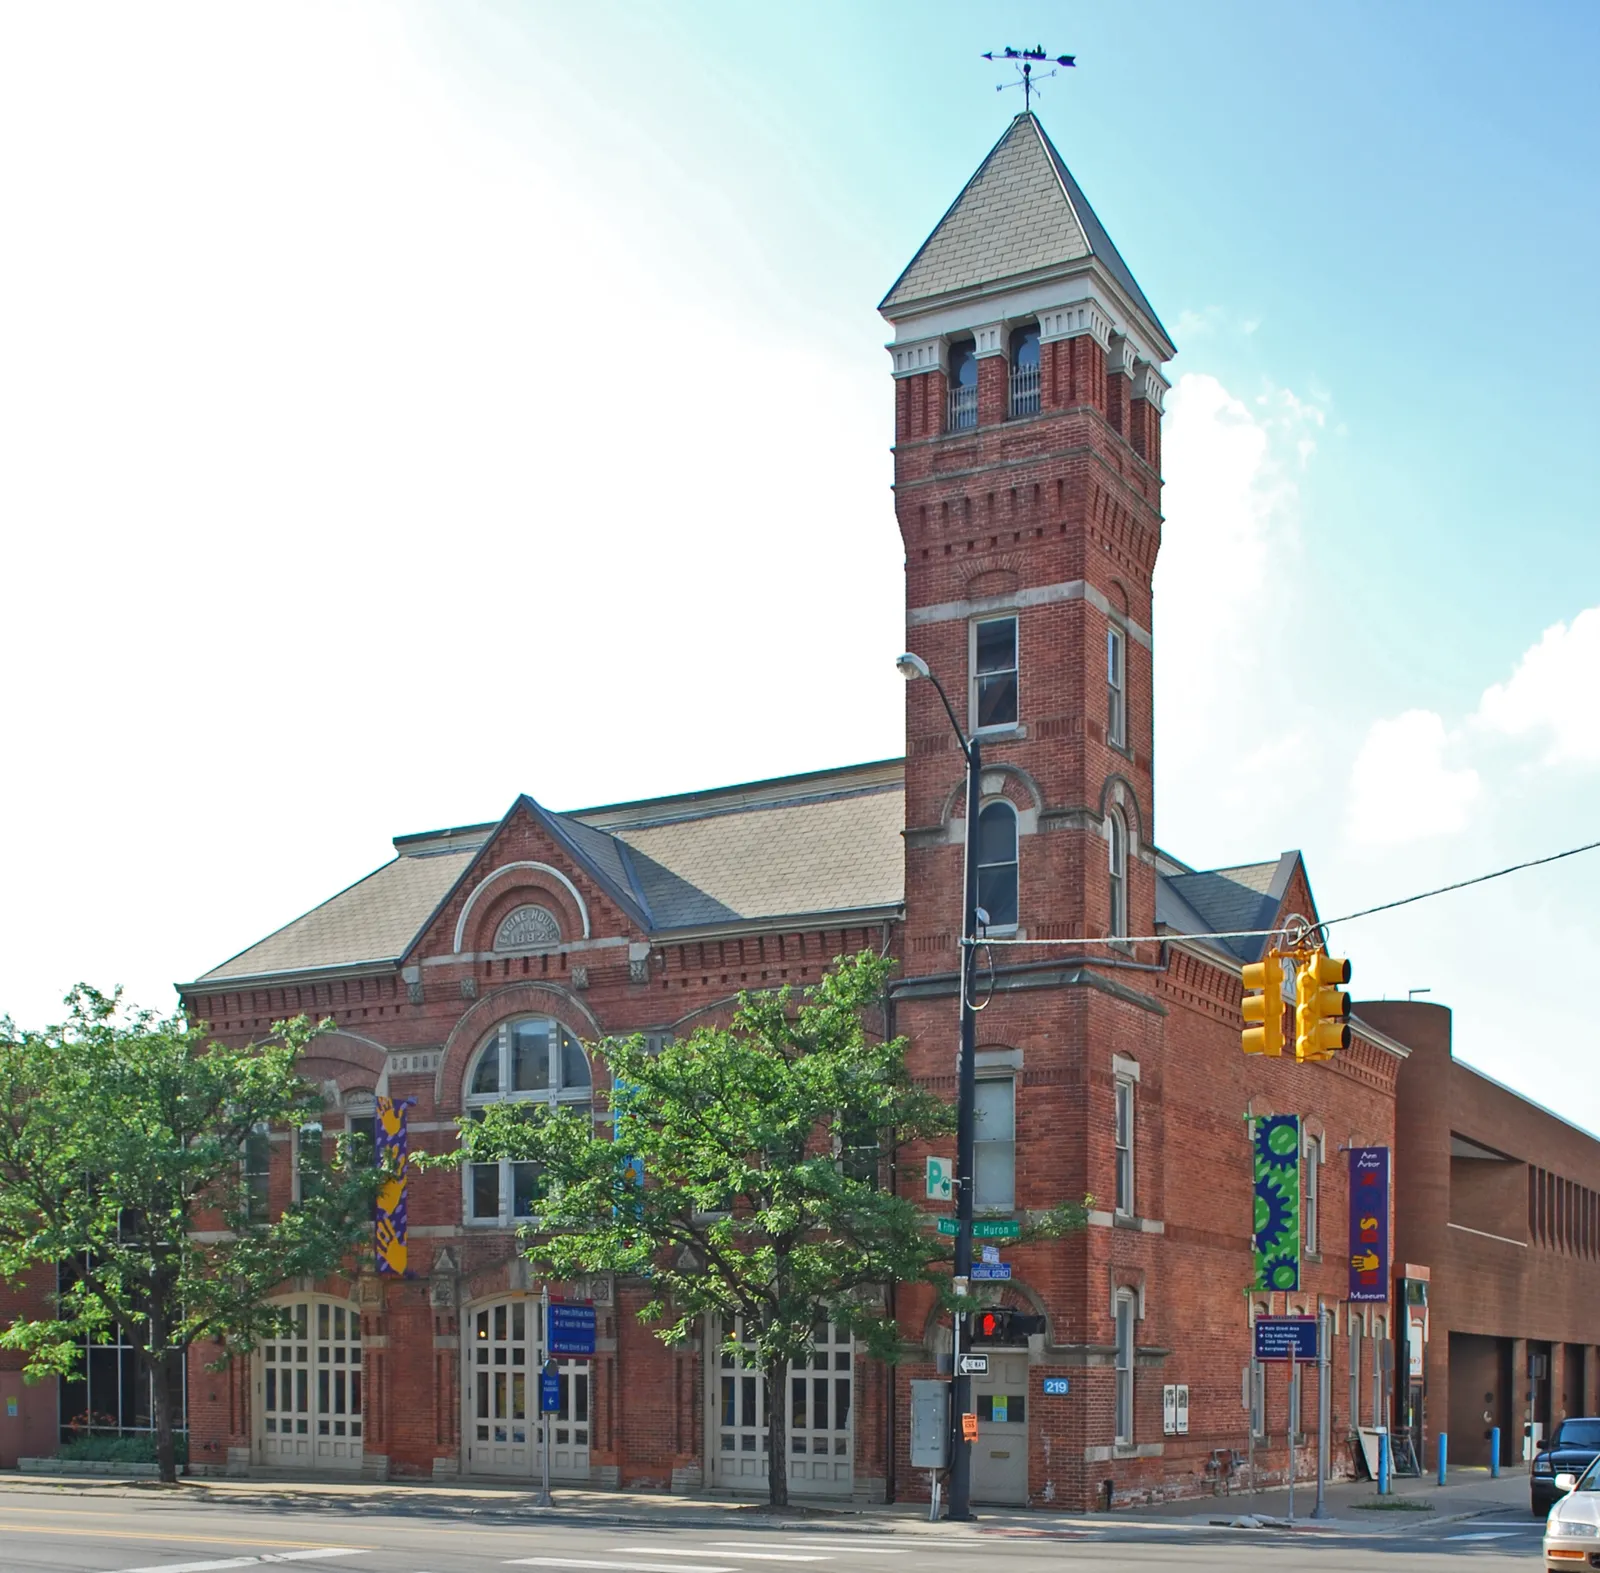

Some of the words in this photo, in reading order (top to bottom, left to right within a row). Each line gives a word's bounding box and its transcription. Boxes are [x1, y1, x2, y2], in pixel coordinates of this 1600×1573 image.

[996, 84, 1003, 92] W
[499, 909, 528, 944] ENGINE
[531, 909, 559, 938] HOUSE
[511, 931, 546, 945] 1882
[1361, 1151, 1378, 1159] Ann
[1357, 1160, 1380, 1168] Arbor
[928, 1160, 942, 1194] P
[983, 1225, 1009, 1235] Huron
[1350, 1291, 1386, 1299] Museum
[966, 1360, 974, 1369] ONE
[974, 1360, 985, 1369] WAY
[1046, 1381, 1067, 1394] 219
